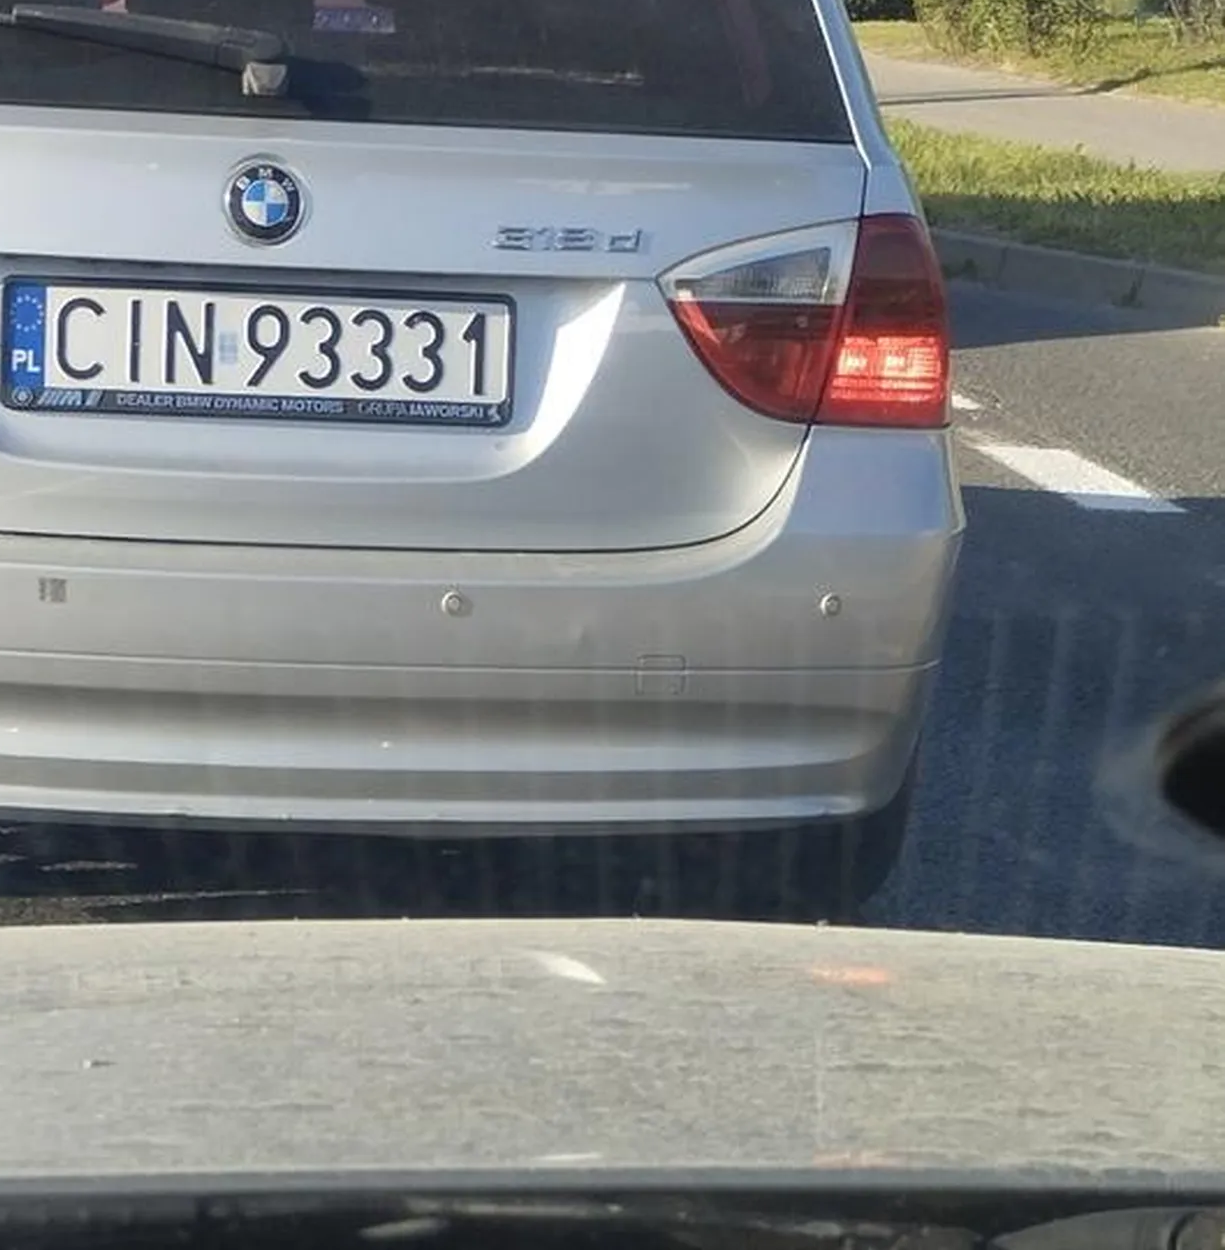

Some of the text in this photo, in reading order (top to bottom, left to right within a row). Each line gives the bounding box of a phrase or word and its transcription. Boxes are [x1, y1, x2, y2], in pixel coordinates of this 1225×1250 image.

[236, 168, 295, 191] BMW
[57, 297, 487, 395] CIN 93331
[11, 351, 40, 373] PL
[117, 393, 345, 414] DEALER BMW DYNAMIC MOTORS
